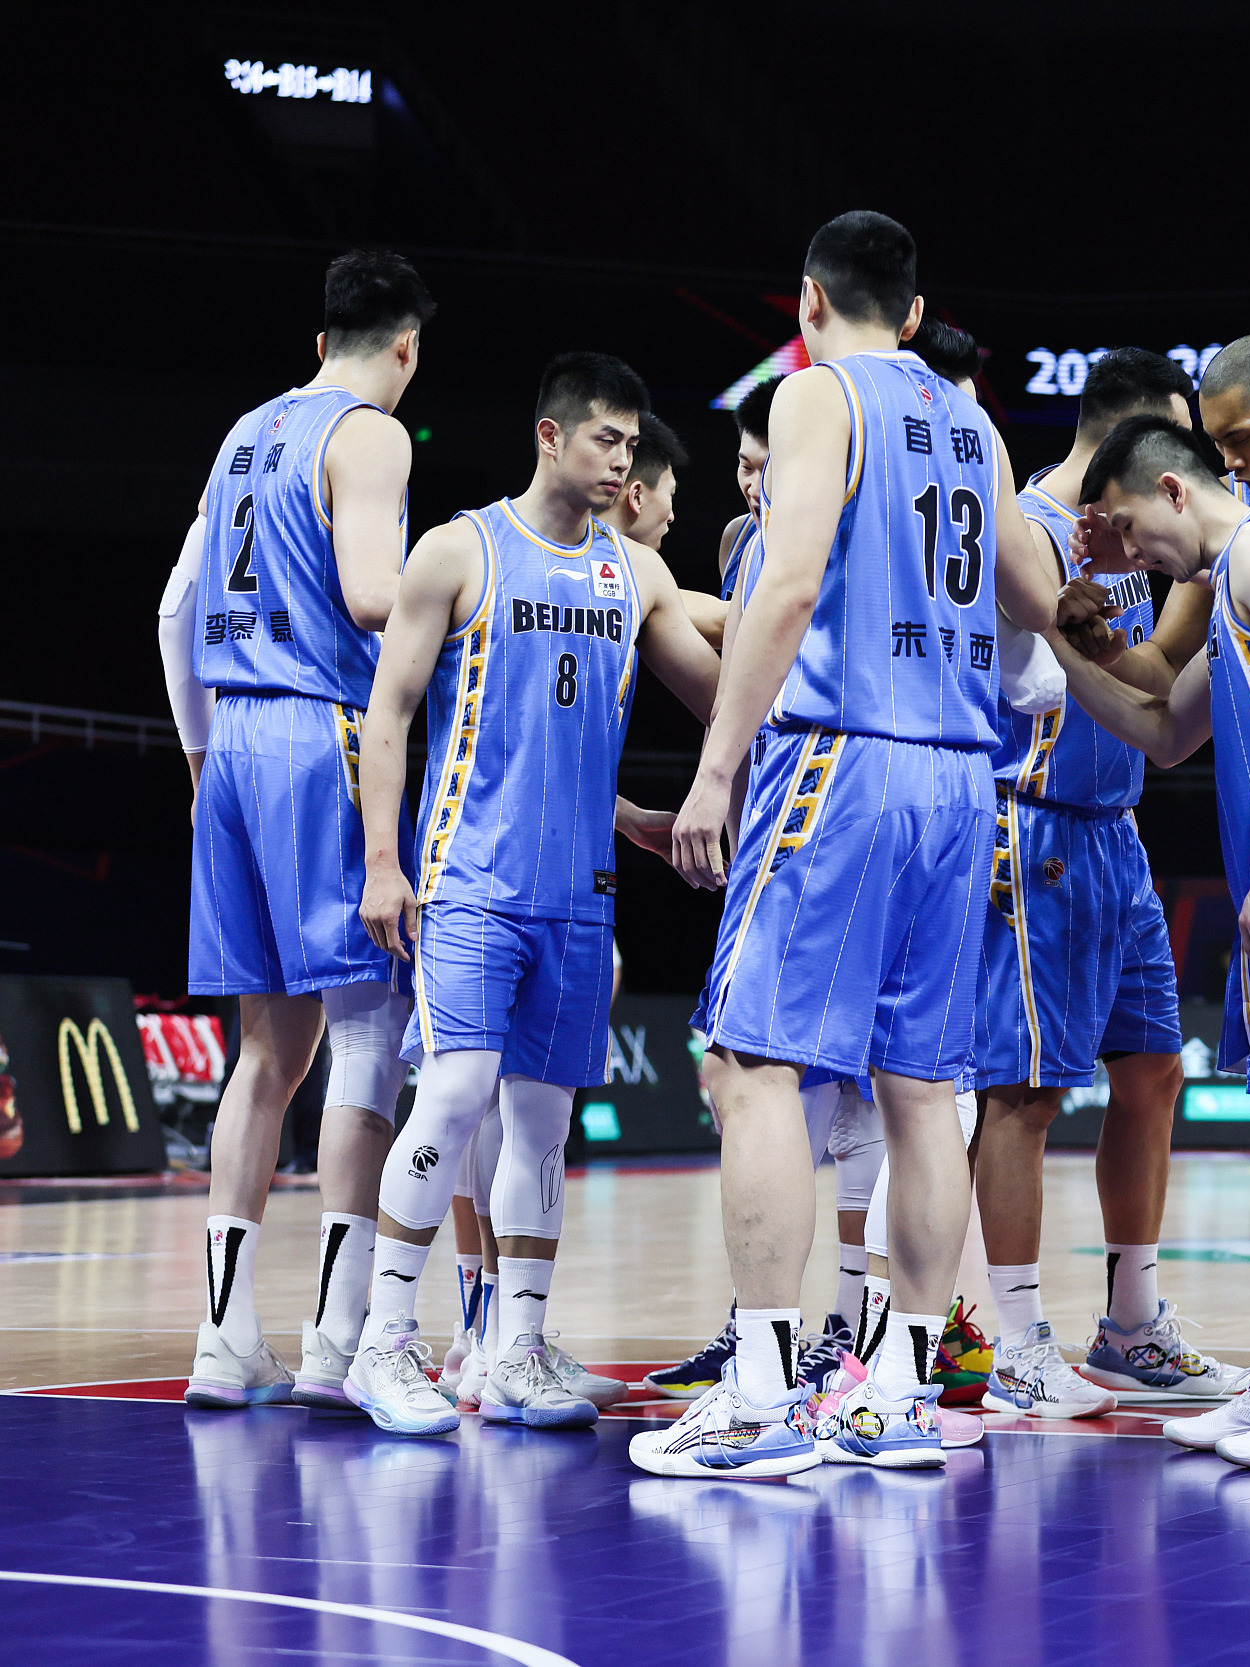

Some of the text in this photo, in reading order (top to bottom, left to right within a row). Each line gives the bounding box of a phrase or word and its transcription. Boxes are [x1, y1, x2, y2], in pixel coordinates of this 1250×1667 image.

[903, 415, 984, 465] 首钢
[226, 492, 259, 594] 2
[912, 482, 985, 609] 13
[511, 597, 624, 645] BEIJING
[555, 652, 578, 709] 8
[407, 1169, 429, 1182] CBA
